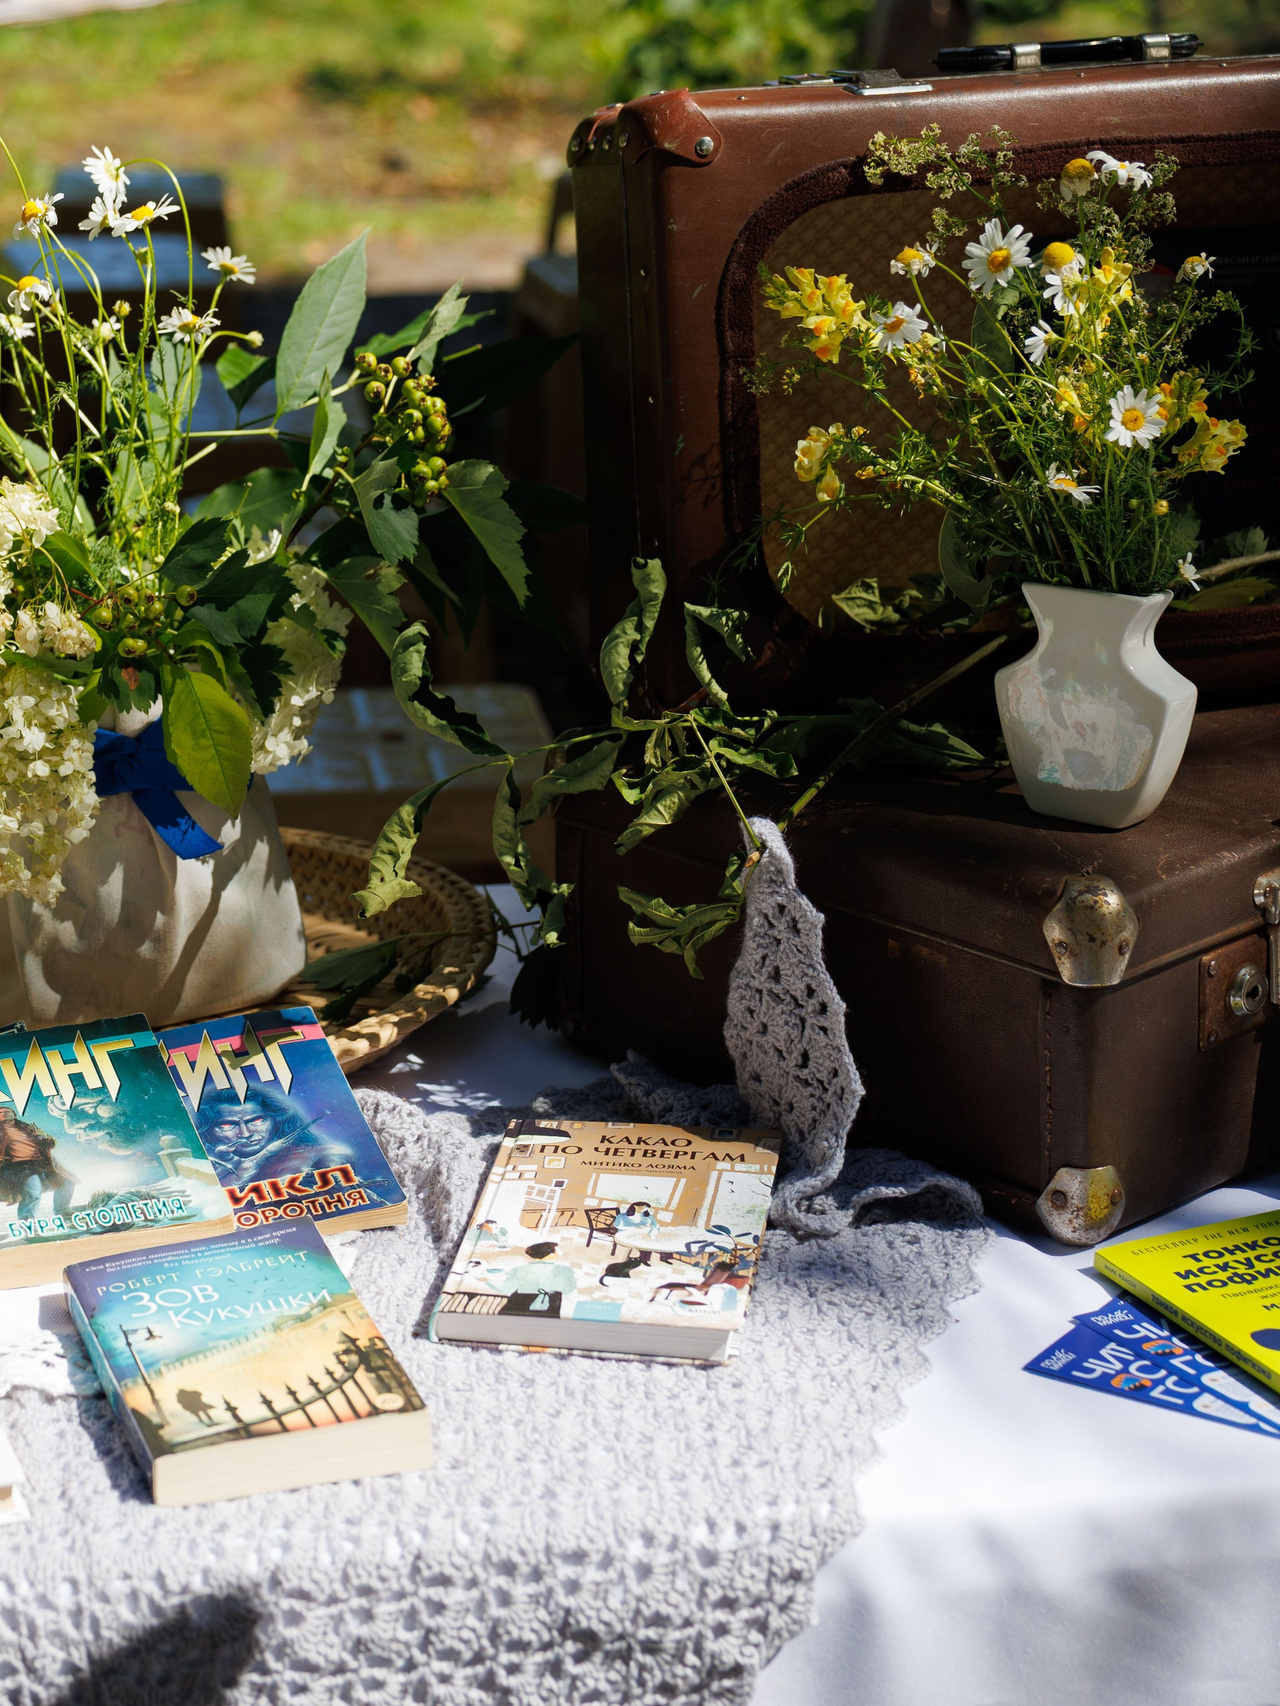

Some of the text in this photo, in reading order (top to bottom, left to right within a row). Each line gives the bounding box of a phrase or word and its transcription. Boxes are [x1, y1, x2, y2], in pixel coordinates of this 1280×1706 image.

[159, 1021, 306, 1112] ИНГ
[539, 1144, 746, 1162] ПО ЧЕТВЕРГАМ
[599, 1135, 693, 1148] КАКАО
[580, 1160, 697, 1171] МИТИКО АОЯМА
[8, 1197, 187, 1238] БУРЯ СТОЛЕТИЯ
[272, 1226, 297, 1239] время
[1131, 1237, 1199, 1256] БЕСТСЕЛЛЕР
[1204, 1231, 1223, 1241] THE
[1228, 1226, 1250, 1237] NEW
[96, 1250, 309, 1297] РОБЕРТ ГЭЛБРЕЙТ
[122, 1284, 220, 1318] ЗОВ
[167, 1288, 333, 1330] КУКУШКИ
